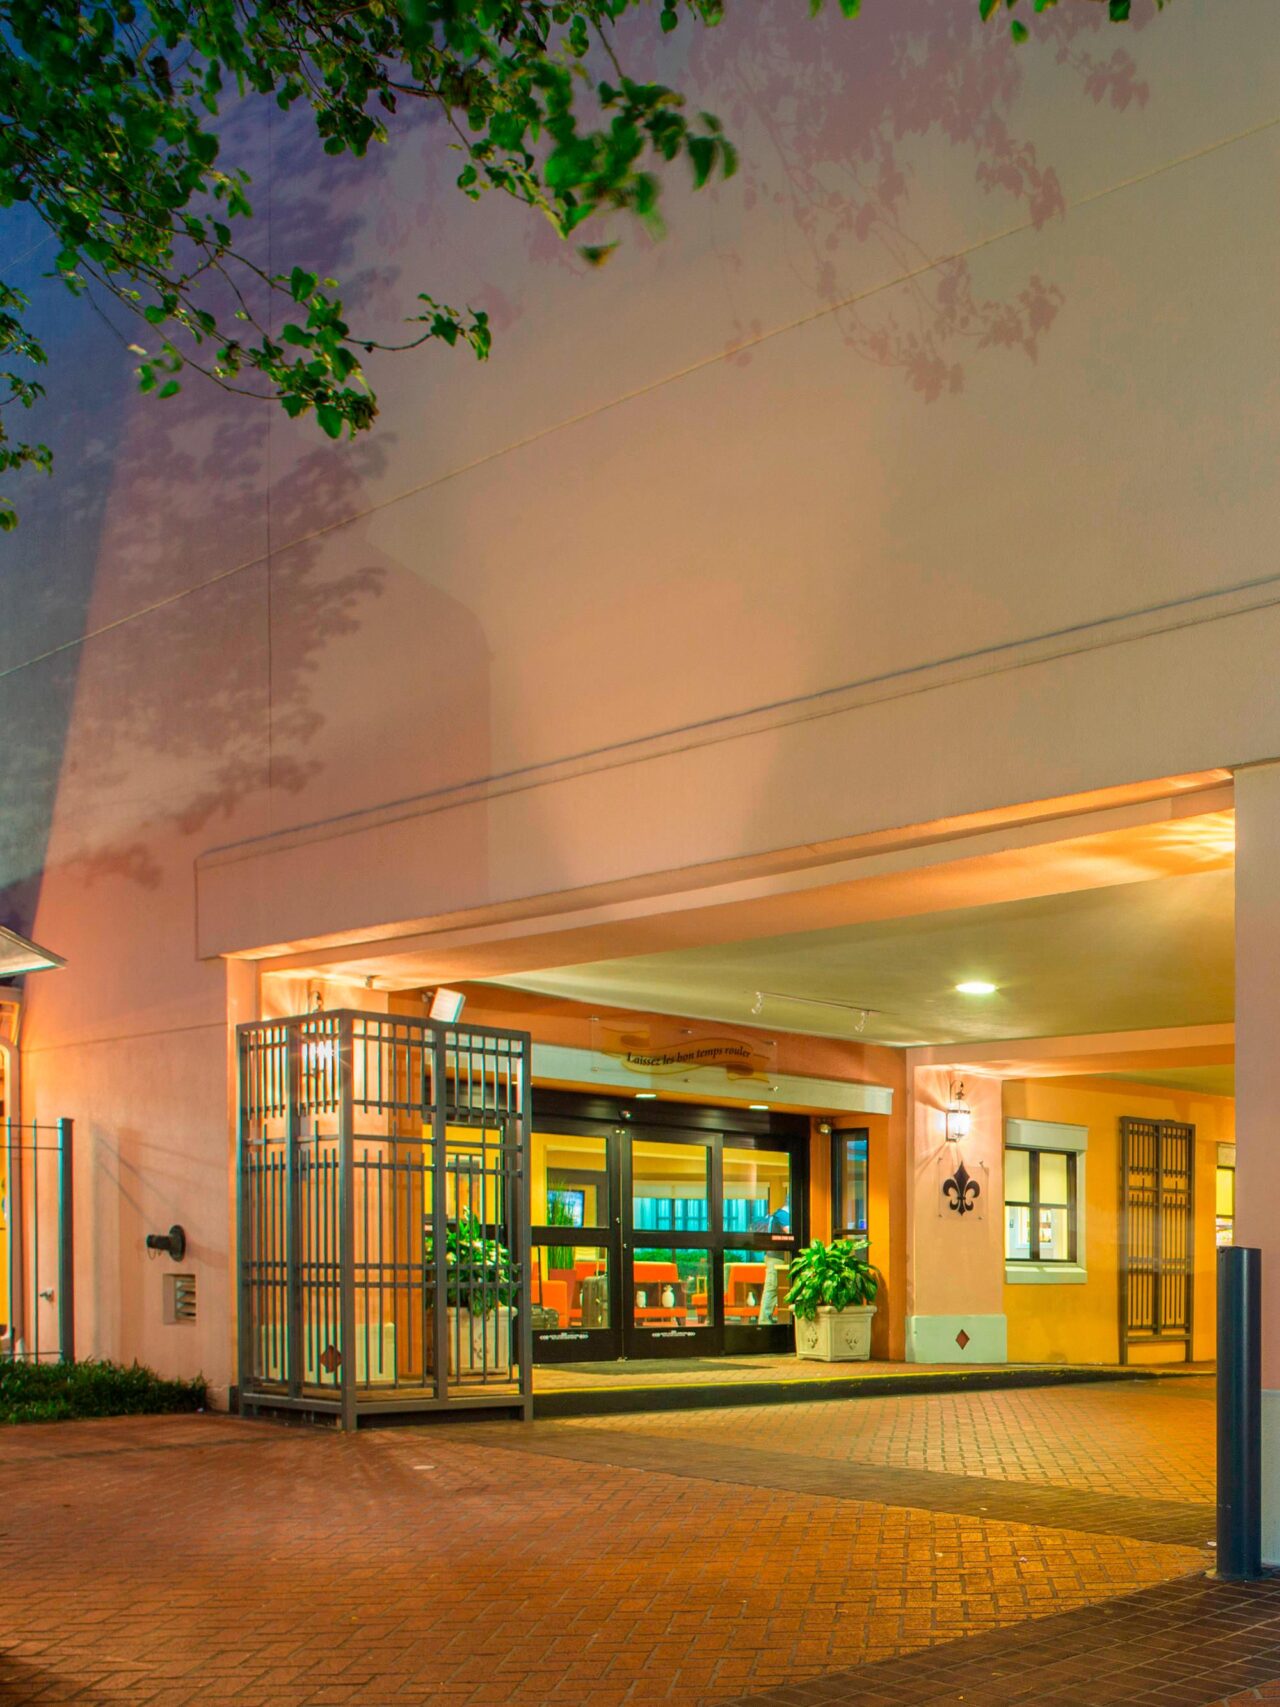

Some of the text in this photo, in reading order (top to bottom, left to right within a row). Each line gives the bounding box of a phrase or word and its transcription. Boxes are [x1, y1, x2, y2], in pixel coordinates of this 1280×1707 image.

[627, 1051, 661, 1066] Laissez
[662, 1054, 675, 1065] les
[696, 1048, 723, 1059] temps
